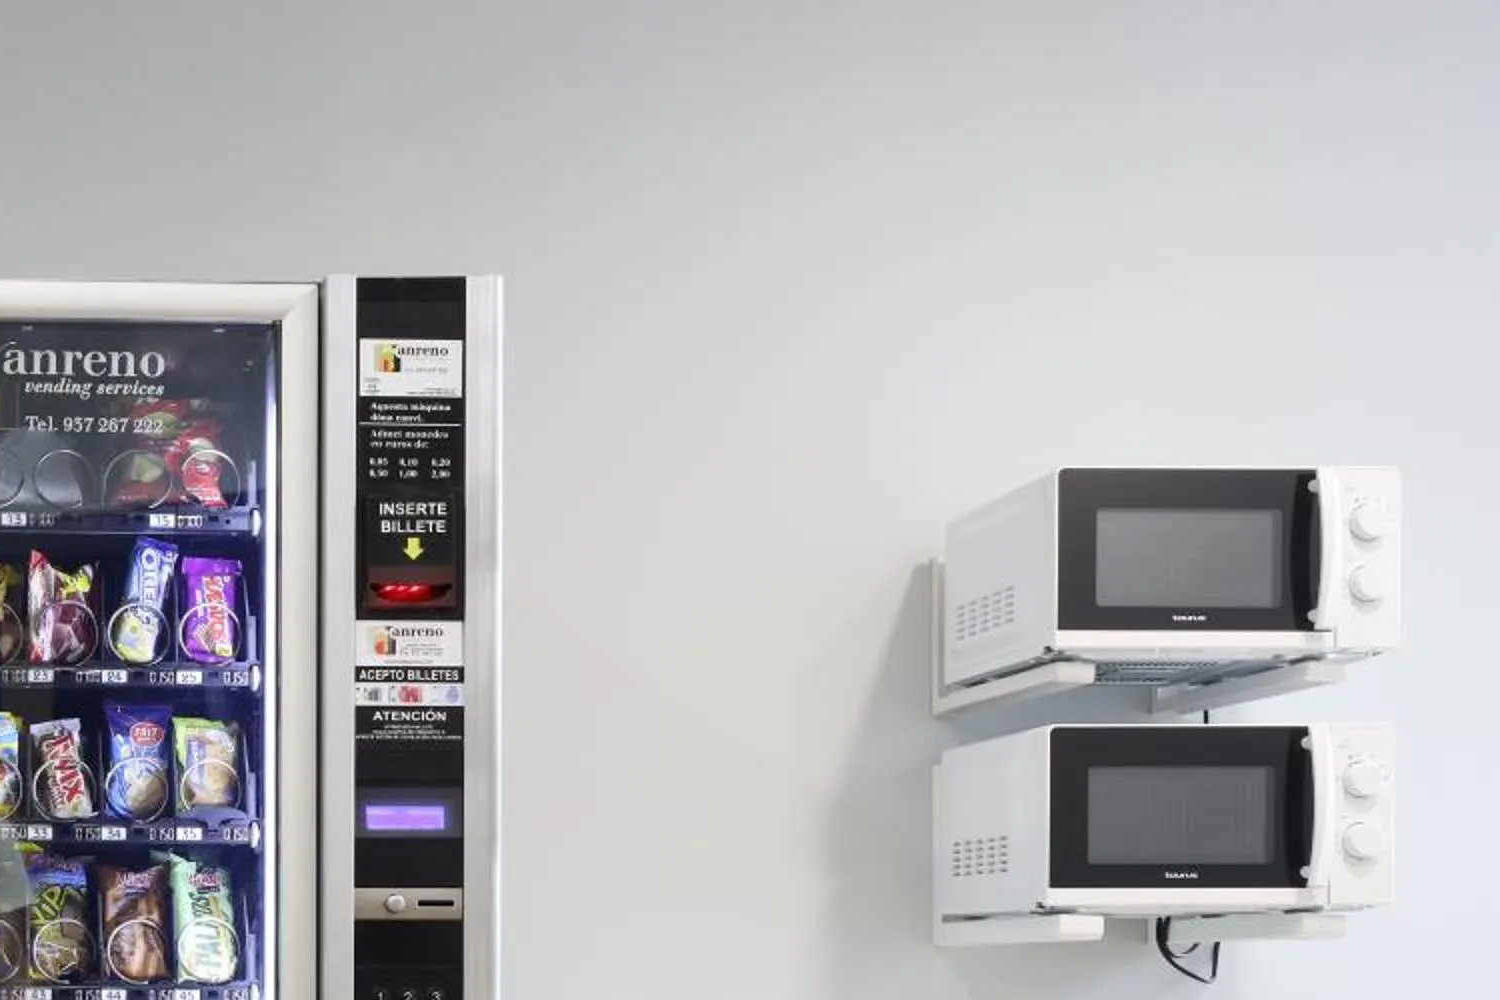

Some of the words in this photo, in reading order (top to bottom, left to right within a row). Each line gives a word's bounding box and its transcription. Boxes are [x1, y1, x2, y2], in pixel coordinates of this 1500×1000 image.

[24, 378, 93, 400] vending
[96, 380, 165, 396] services
[24, 415, 59, 432] Tel.
[63, 417, 96, 432] 957
[97, 418, 129, 433] 267
[133, 418, 164, 433] 222
[379, 501, 448, 516] INSERTE
[380, 519, 447, 533] BILLETE
[359, 669, 405, 681] ACEPTO
[407, 669, 459, 681] BILLETES
[373, 708, 447, 721] ATENCIÓN
